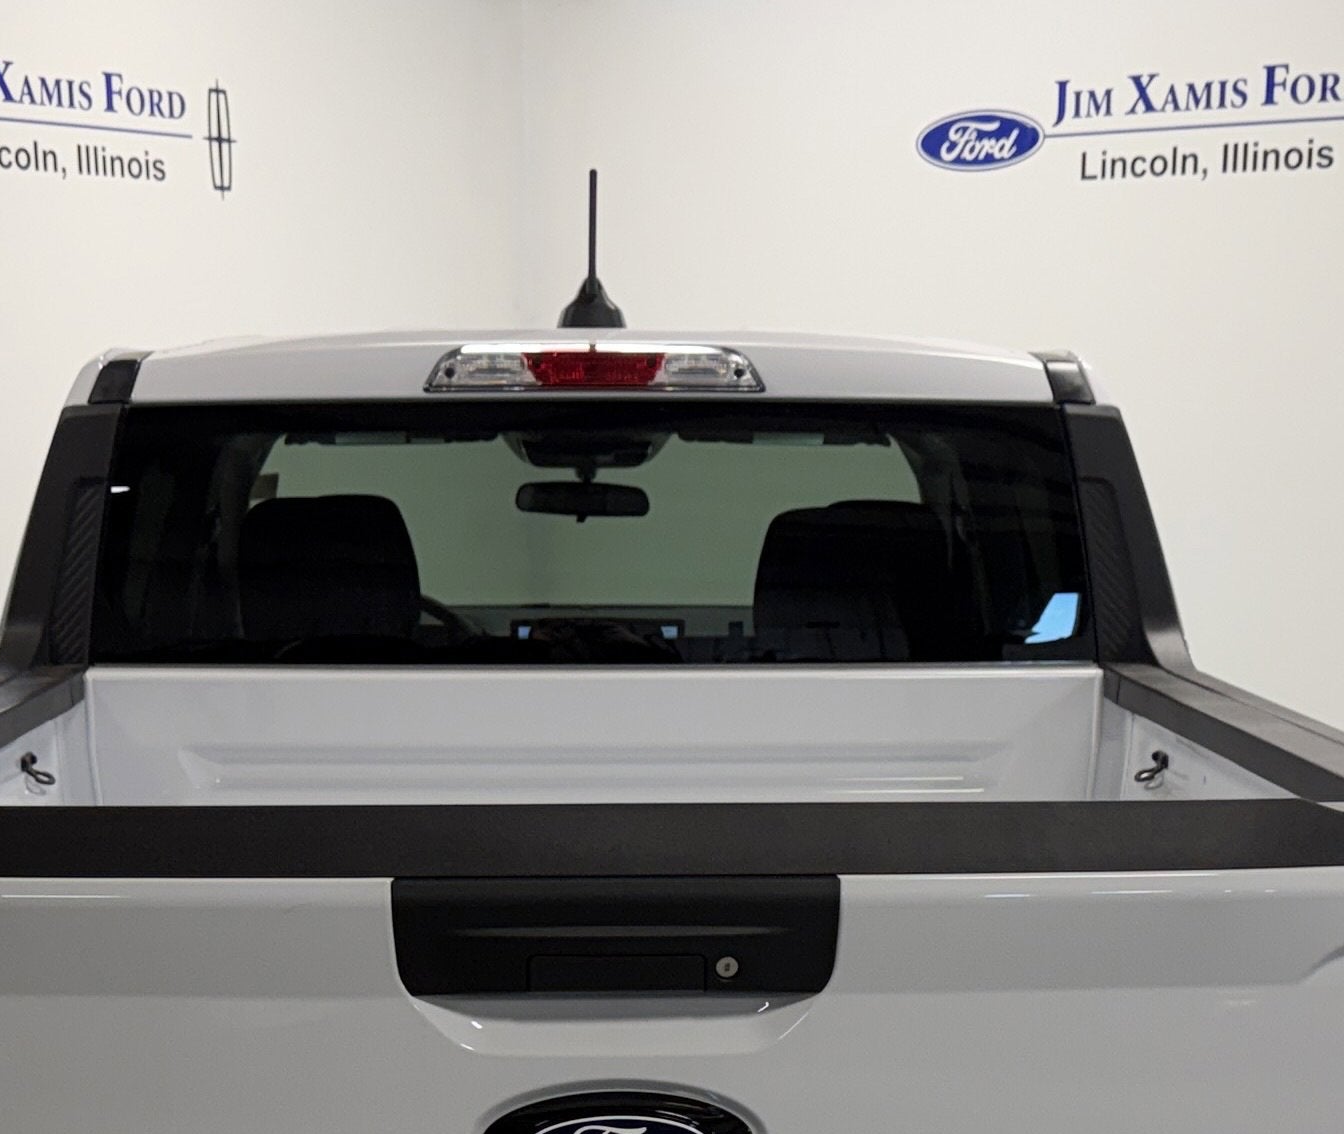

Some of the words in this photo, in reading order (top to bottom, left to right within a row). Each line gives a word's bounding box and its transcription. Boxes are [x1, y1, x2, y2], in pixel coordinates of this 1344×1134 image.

[102, 71, 186, 121] FORD
[1052, 79, 1114, 128] JIM
[1125, 73, 1249, 116] XAMIS
[940, 120, 1017, 162] Ford
[1080, 146, 1209, 181] Lincoln,
[1221, 138, 1335, 174] Illinois
[77, 144, 167, 182] Illinois
